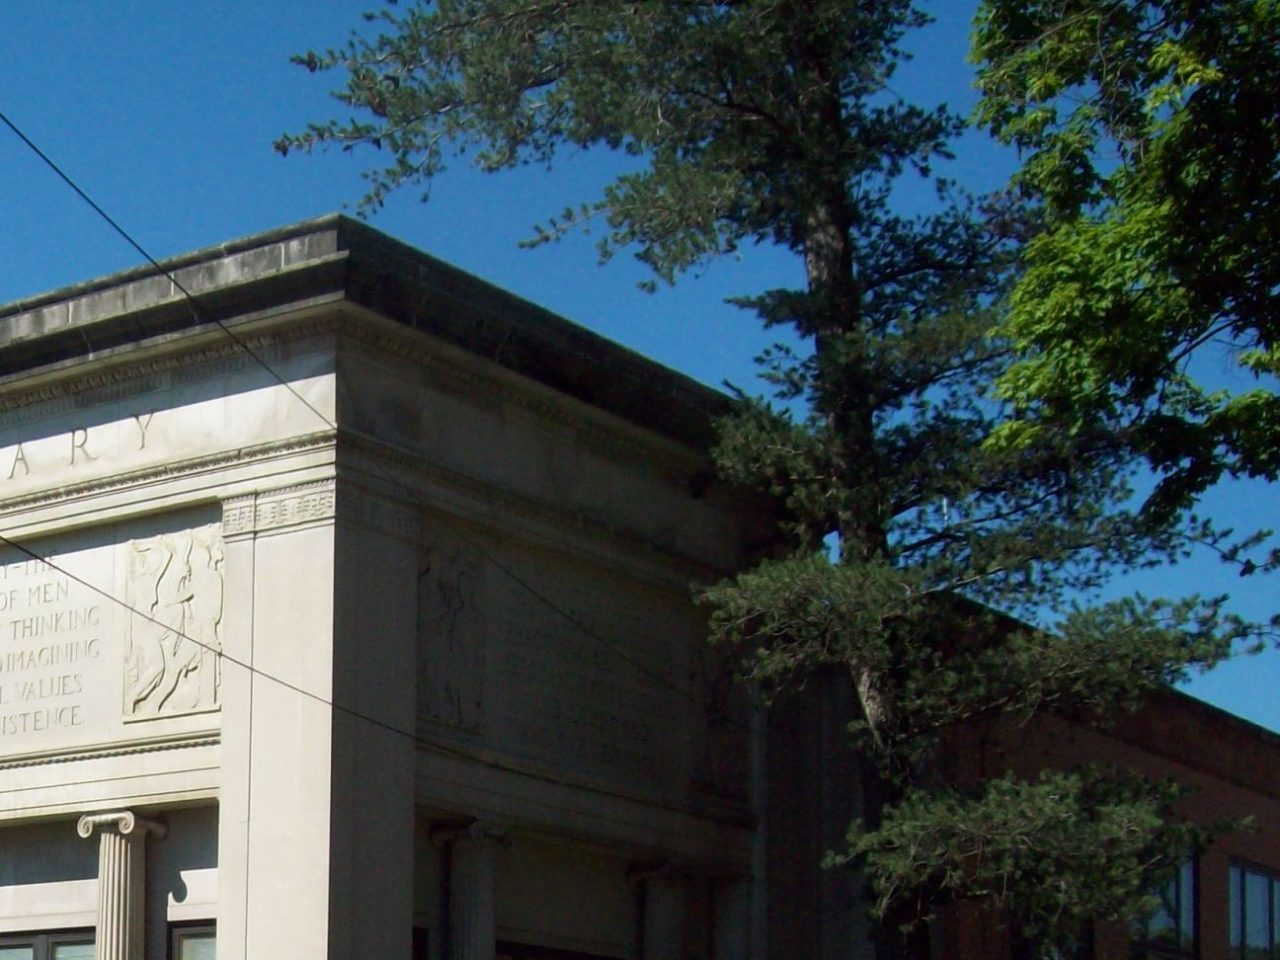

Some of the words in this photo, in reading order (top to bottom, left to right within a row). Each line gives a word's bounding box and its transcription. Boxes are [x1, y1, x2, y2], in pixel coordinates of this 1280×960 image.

[28, 579, 69, 607] MEN
[9, 606, 100, 640] THINKING
[15, 673, 83, 701] VALUES
